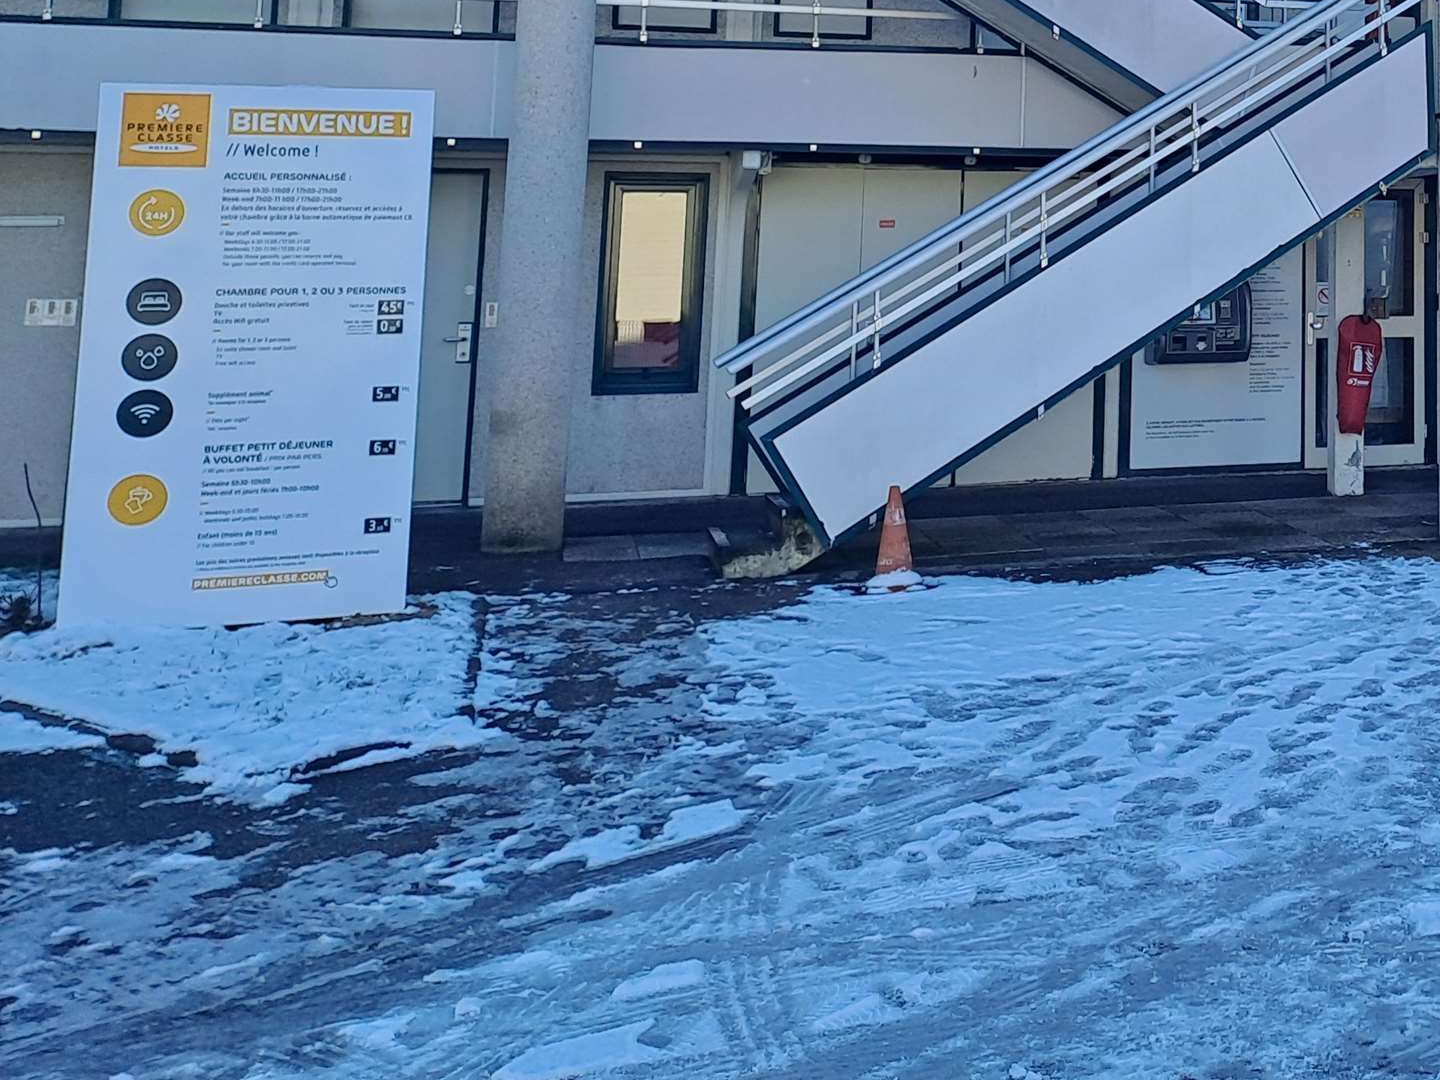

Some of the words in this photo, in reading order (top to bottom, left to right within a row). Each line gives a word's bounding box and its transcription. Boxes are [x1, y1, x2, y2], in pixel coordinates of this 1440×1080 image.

[126, 122, 204, 134] PREMIERE
[232, 111, 395, 134] BIENVENUE
[136, 133, 193, 143] CLASSE
[243, 143, 311, 158] Welcome
[224, 172, 268, 182] ACCUEIL
[270, 172, 347, 182] PERSONNALISÉ
[145, 211, 168, 221] 24H
[215, 288, 267, 297] CHAMBRE
[270, 288, 298, 296] POUR
[311, 288, 317, 296] 2
[320, 287, 335, 296] OU
[337, 287, 343, 296] 3
[346, 286, 406, 296] PERSONNES
[204, 443, 245, 454] BUFFET
[247, 441, 277, 452] PETIT
[278, 439, 333, 451] DÉJEUNER
[213, 453, 263, 464] VOLONTÉ
[192, 571, 328, 589] PREMIERECLASSE.COM
